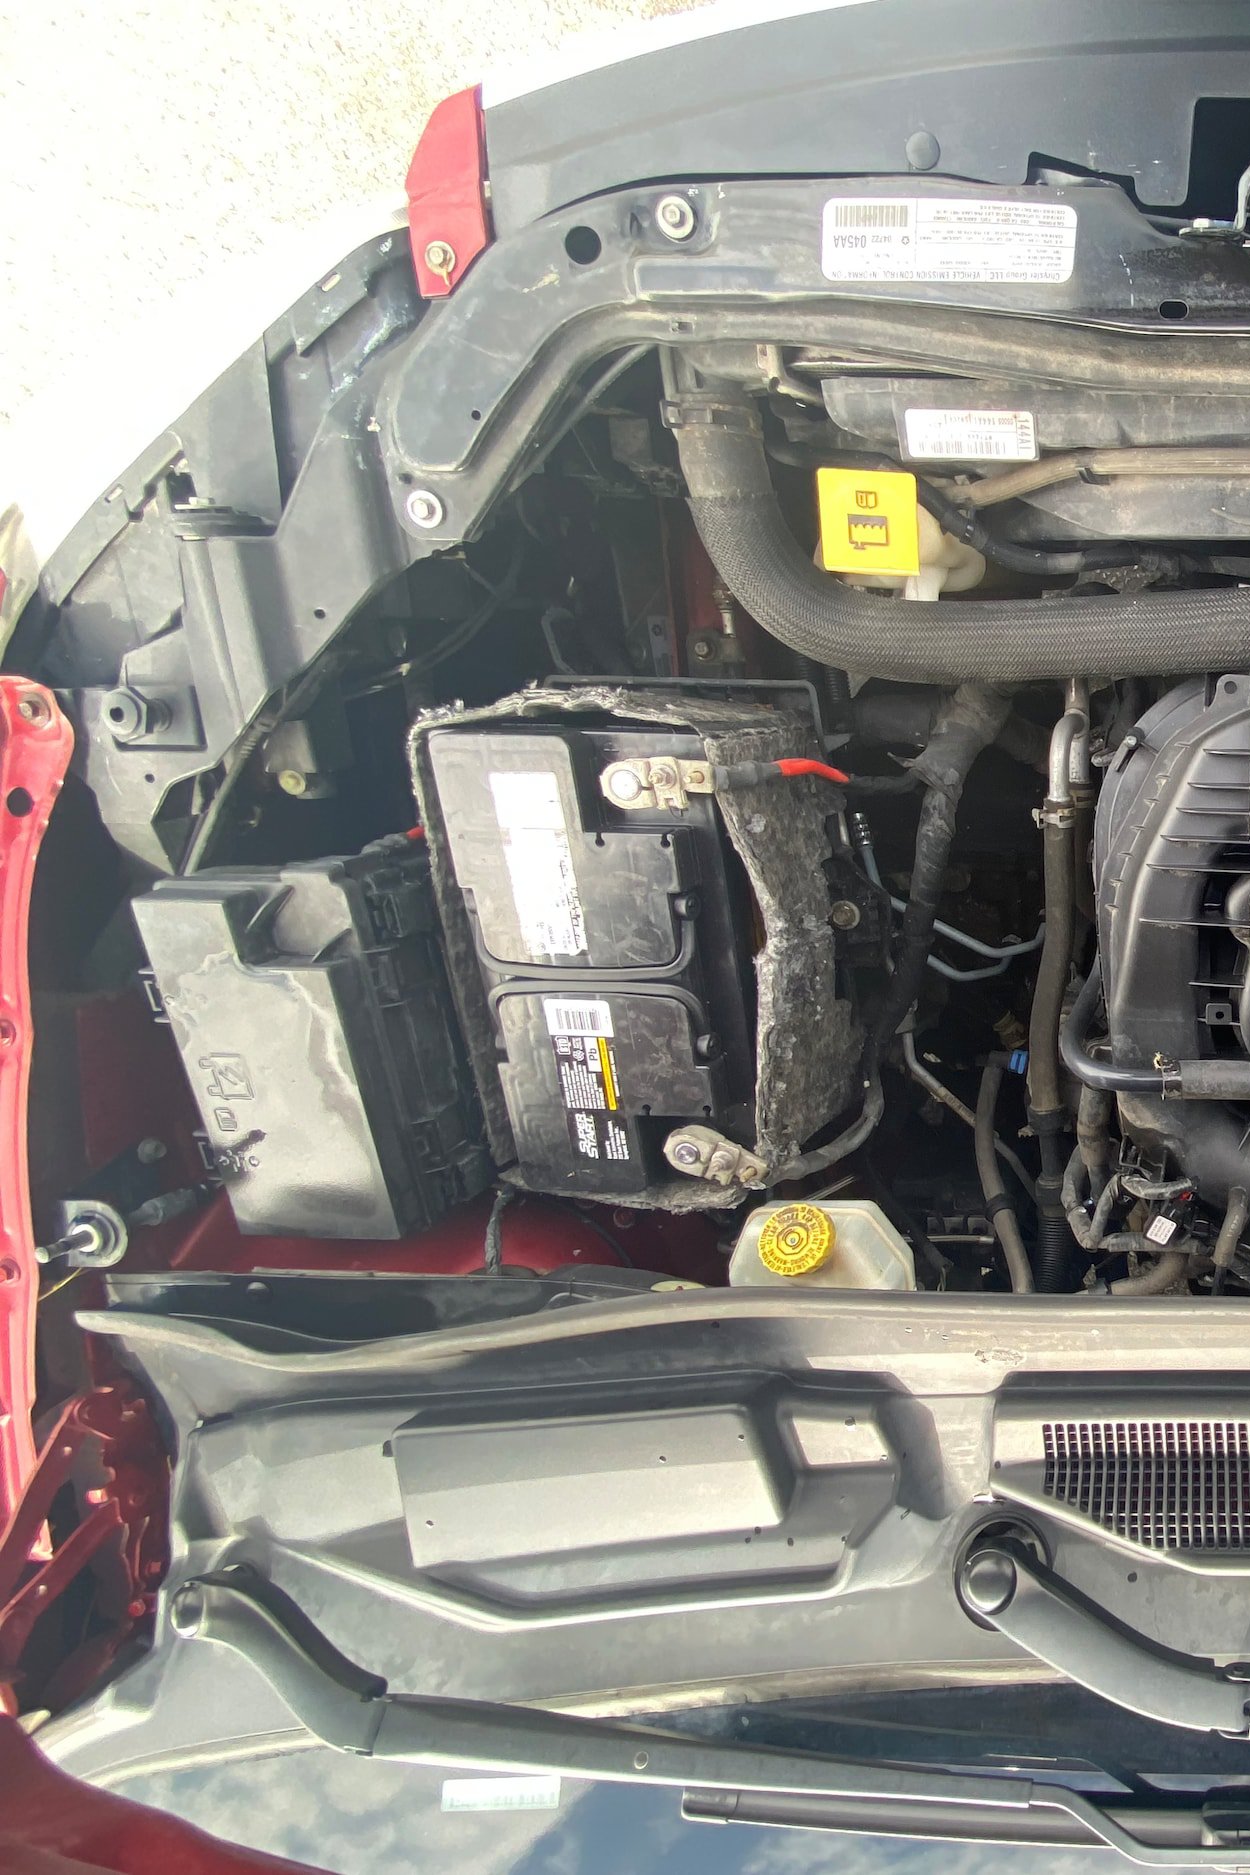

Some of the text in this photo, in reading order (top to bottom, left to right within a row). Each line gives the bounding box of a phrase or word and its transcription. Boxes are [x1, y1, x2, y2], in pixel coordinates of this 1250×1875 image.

[833, 234, 867, 248] 045AA
[830, 269, 878, 280] NFORMAON
[916, 269, 950, 280] EMISSION
[951, 269, 981, 280] VEHICLE
[989, 270, 1061, 281] Chrysler Group LLC
[588, 1047, 599, 1061] Pb
[575, 1113, 589, 1153] SUPER
[586, 1115, 599, 1159] START
